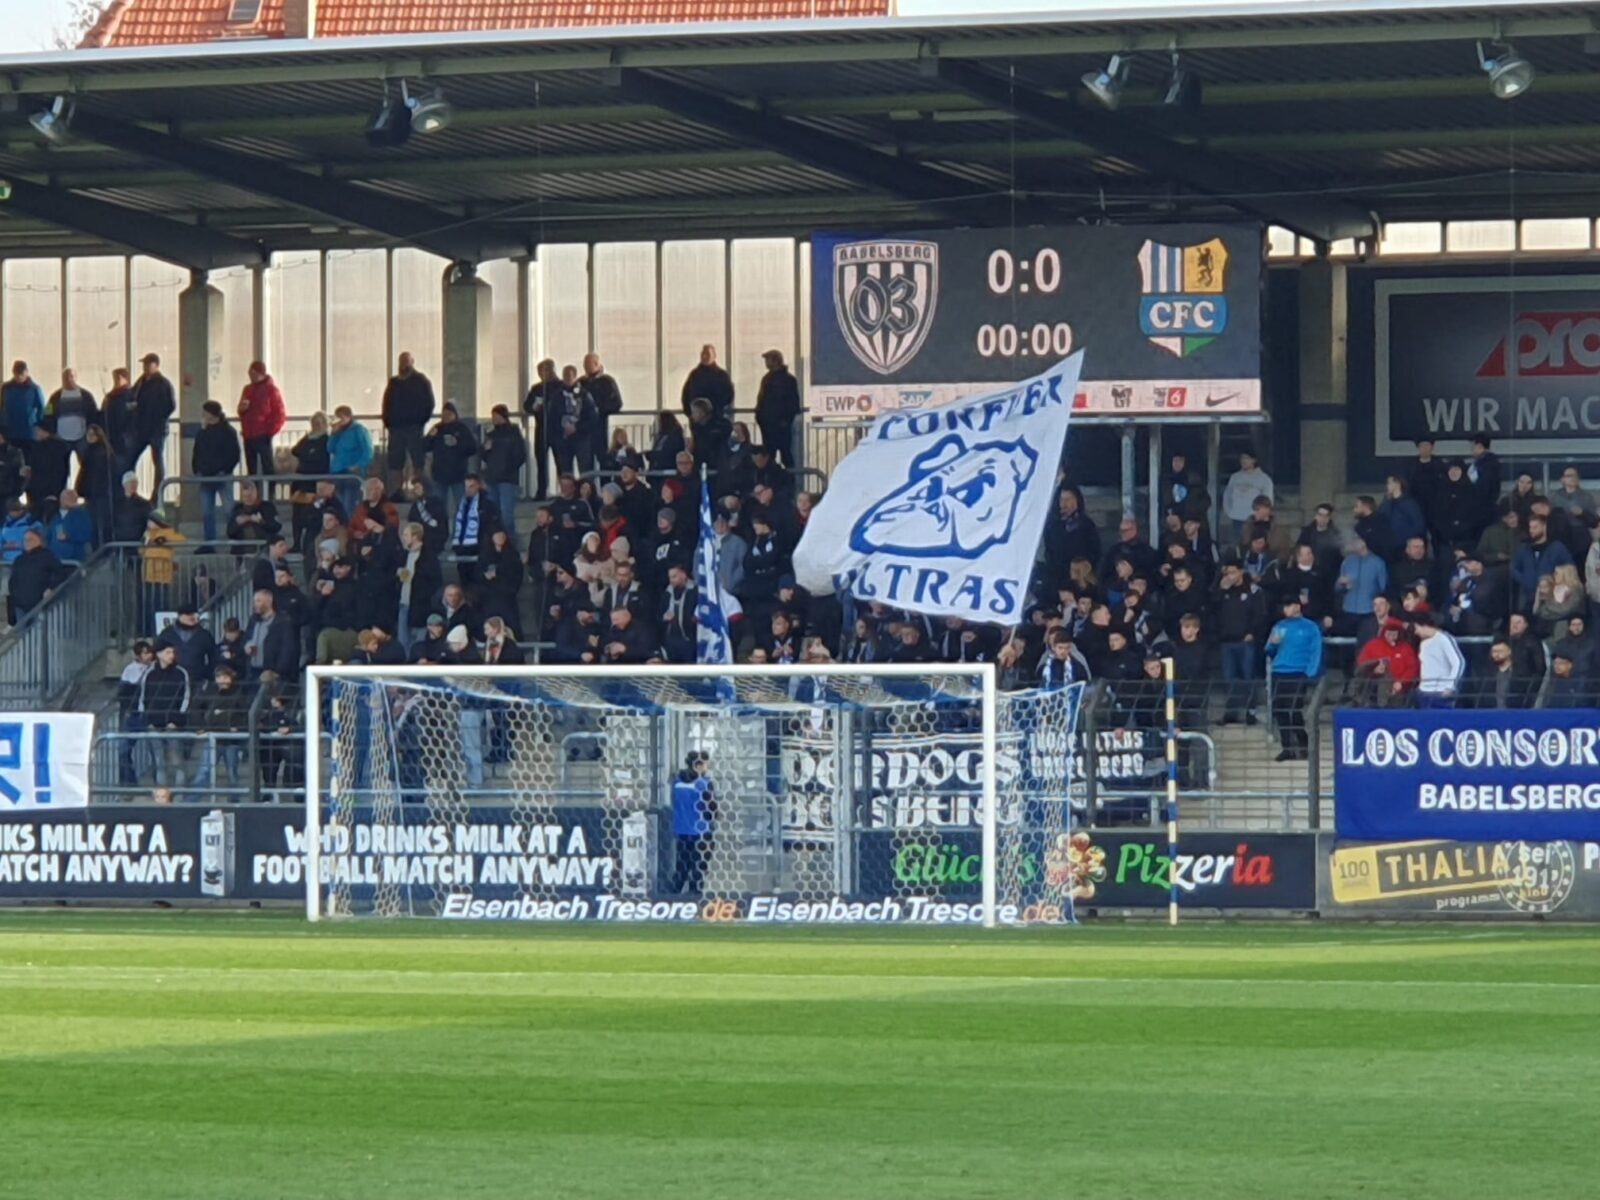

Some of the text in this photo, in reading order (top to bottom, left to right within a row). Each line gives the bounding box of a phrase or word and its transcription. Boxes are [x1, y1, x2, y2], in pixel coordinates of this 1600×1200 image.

[988, 247, 1061, 293] 0:0
[849, 273, 919, 337] 03
[1149, 301, 1214, 329] CFC
[977, 323, 1072, 357] 00:00
[1423, 398, 1500, 432] WIR
[1341, 728, 1600, 767] LOS CONSOR
[1419, 784, 1600, 810] BABELSBERG
[0, 823, 167, 853] KS MILK AT A
[355, 824, 450, 853] DRINKS
[455, 824, 521, 853] MILK
[527, 825, 562, 853] AT
[568, 826, 587, 854] A
[65, 854, 193, 883] ANYWAY?
[383, 854, 474, 885] MATCH
[480, 855, 614, 885] ANYWAY?
[1115, 843, 1274, 891] Pizzeria
[1339, 842, 1510, 885] 100 THALIA
[442, 894, 589, 920] Eisenbach
[749, 896, 900, 922] Eisenbach
